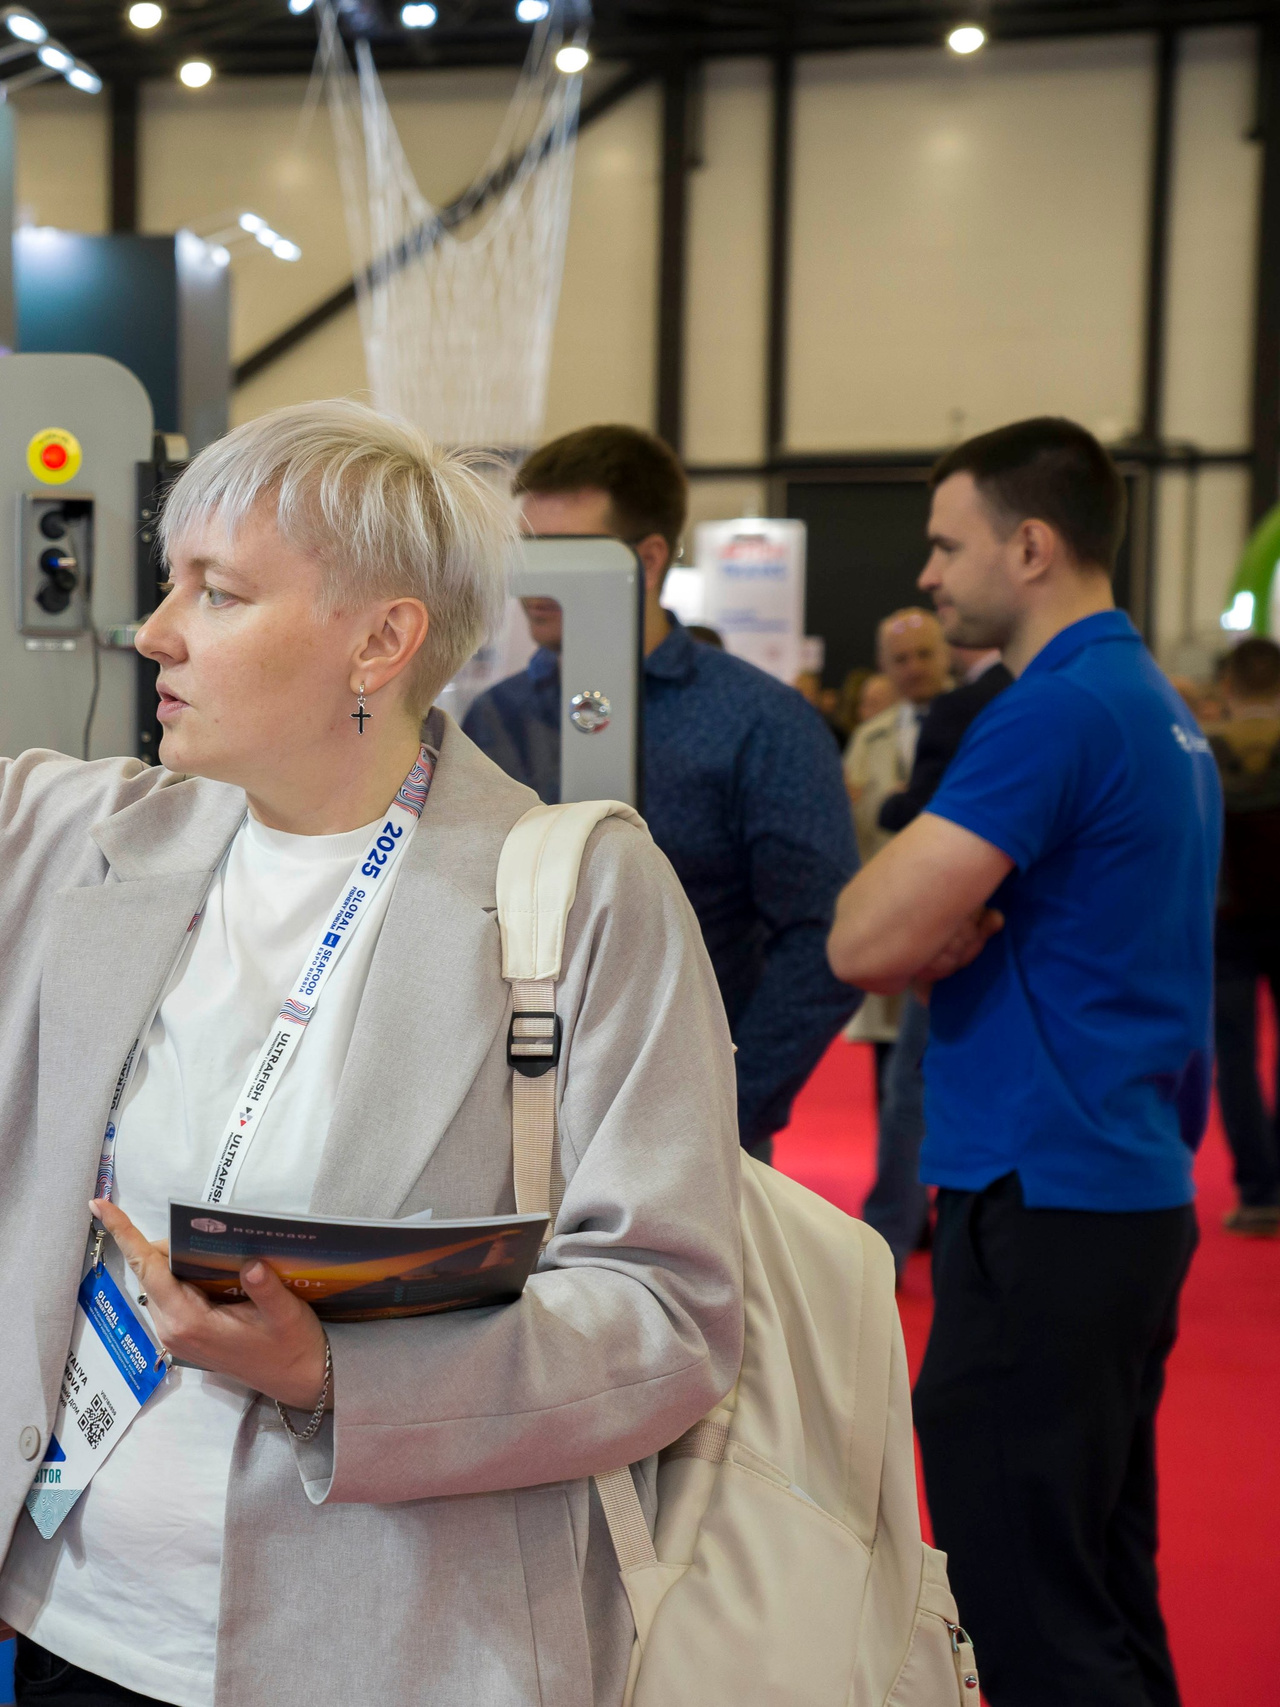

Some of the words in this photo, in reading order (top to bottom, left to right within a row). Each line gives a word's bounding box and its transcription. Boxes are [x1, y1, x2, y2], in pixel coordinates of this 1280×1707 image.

[361, 821, 403, 879] 2025
[335, 890, 366, 931] GLOBAL
[341, 886, 357, 911] FISHERY
[330, 909, 345, 930] FORUM
[305, 949, 332, 996] SEAFOOD
[312, 947, 324, 966] EXPO
[298, 967, 315, 993] RUSSIA
[251, 1033, 291, 1101] ULTRAFISH
[97, 1290, 120, 1326] GLOBAL
[67, 1350, 88, 1386] TALIYA
[120, 1340, 131, 1355] EXPO
[129, 1354, 144, 1374] RUSSIA
[124, 1334, 148, 1370] SEAFOOD
[33, 1468, 62, 1484] SITOR
